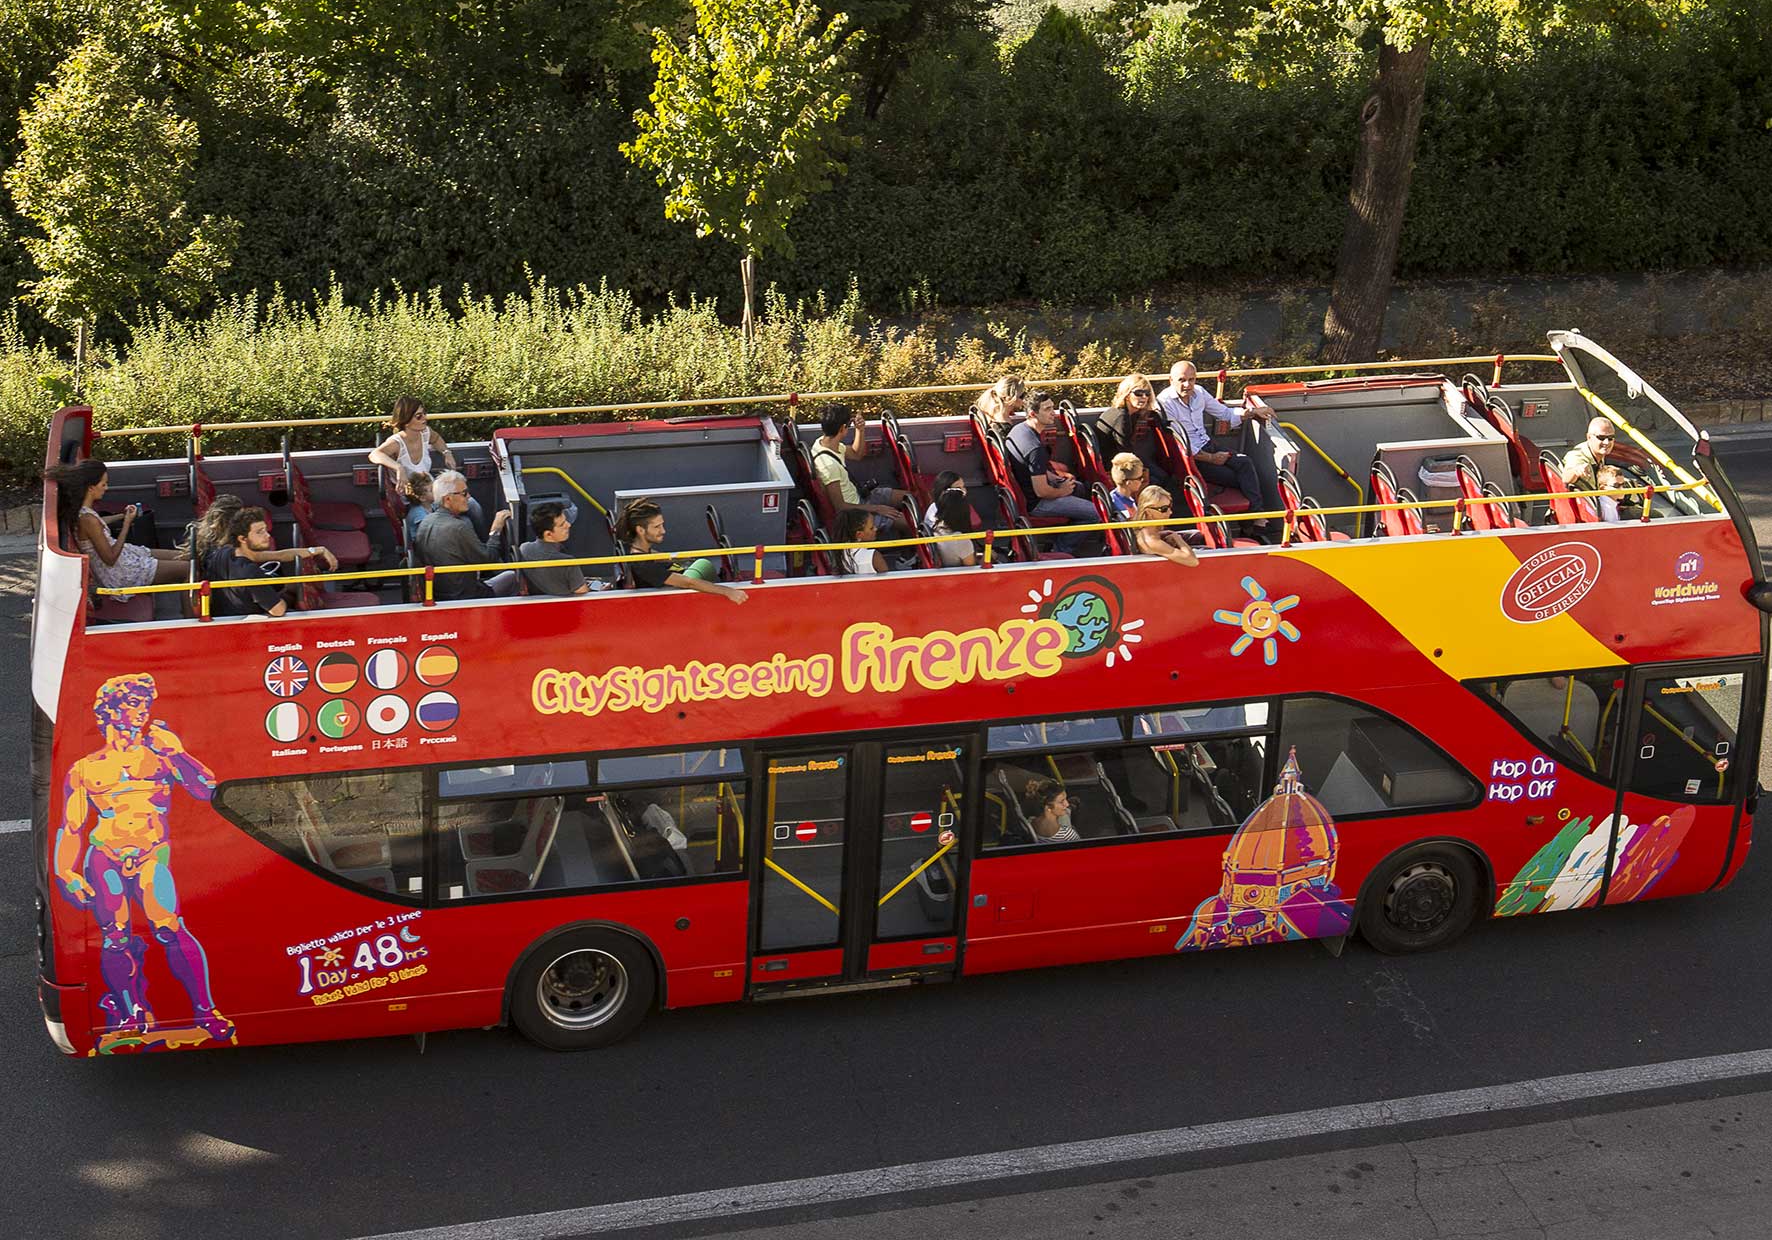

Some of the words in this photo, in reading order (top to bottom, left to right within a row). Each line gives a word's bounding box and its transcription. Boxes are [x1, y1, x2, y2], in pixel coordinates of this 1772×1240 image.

[1523, 550, 1557, 572] TOUR
[1518, 561, 1584, 604] OFFICIAL
[1534, 609, 1550, 620] OF
[1551, 577, 1592, 614] FIRENZE
[268, 642, 303, 653] English
[316, 638, 355, 649] Deutsch
[367, 635, 408, 645] Français
[421, 632, 458, 642] Español
[532, 653, 833, 716] CitySightseeing
[841, 619, 1070, 693] Firenze
[271, 747, 307, 757] Italiano
[371, 737, 409, 750] 日本語
[1492, 760, 1527, 778] Hop
[1531, 756, 1554, 775] On
[1489, 783, 1524, 801] Hop
[1528, 779, 1556, 798] Off
[286, 938, 326, 956] Biglietto
[356, 924, 373, 936] per
[375, 920, 386, 929] le
[387, 917, 395, 926] 3
[396, 910, 422, 923] Linee
[300, 957, 313, 994] 1
[317, 968, 348, 987] Day
[353, 935, 404, 971] 48
[404, 946, 429, 961] hrs
[311, 989, 344, 1006] Ticket
[343, 980, 371, 997] Valid
[389, 971, 399, 983] 3
[399, 964, 428, 980] Lines
